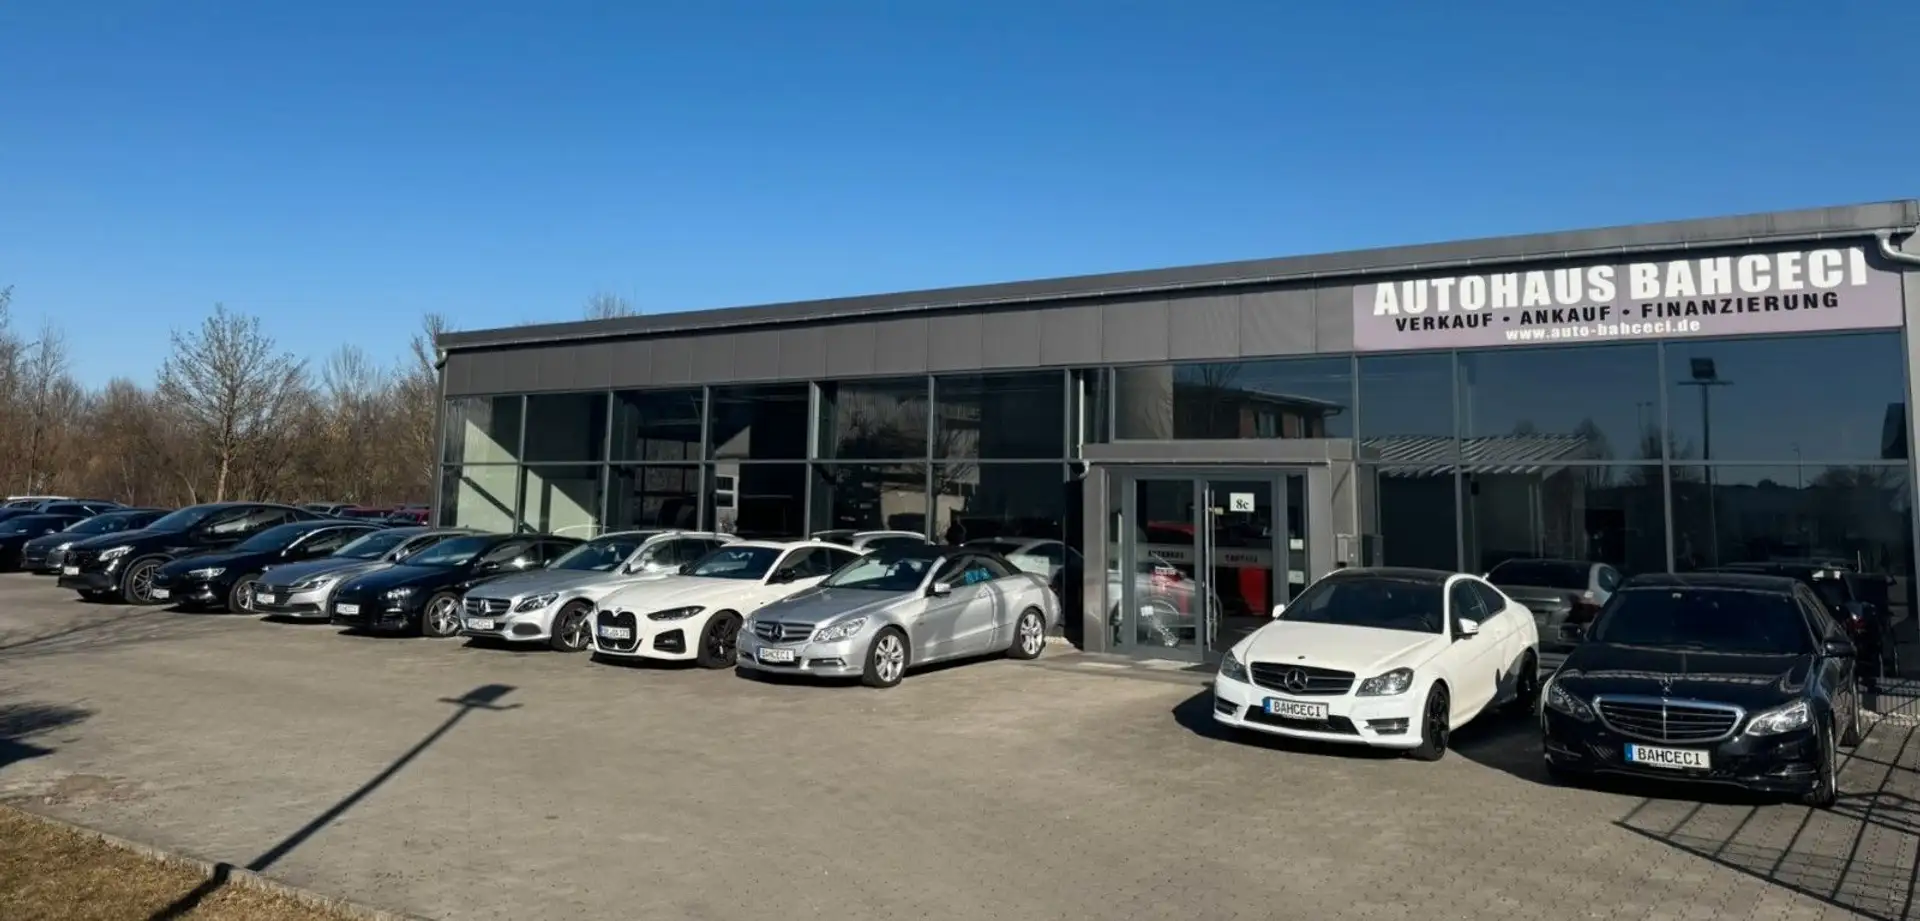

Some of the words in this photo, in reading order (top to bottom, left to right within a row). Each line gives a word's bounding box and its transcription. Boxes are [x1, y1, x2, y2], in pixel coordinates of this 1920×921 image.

[1373, 265, 1617, 316] AUTOHAUS
[1629, 247, 1868, 300] BAHCECI
[1396, 313, 1493, 332] VERKAUF
[1520, 306, 1611, 325] ANKAUF
[1641, 291, 1839, 318] FINANZIERUNG
[1505, 319, 1701, 341] www.auto-bahceci.de
[1235, 498, 1250, 510] 8c
